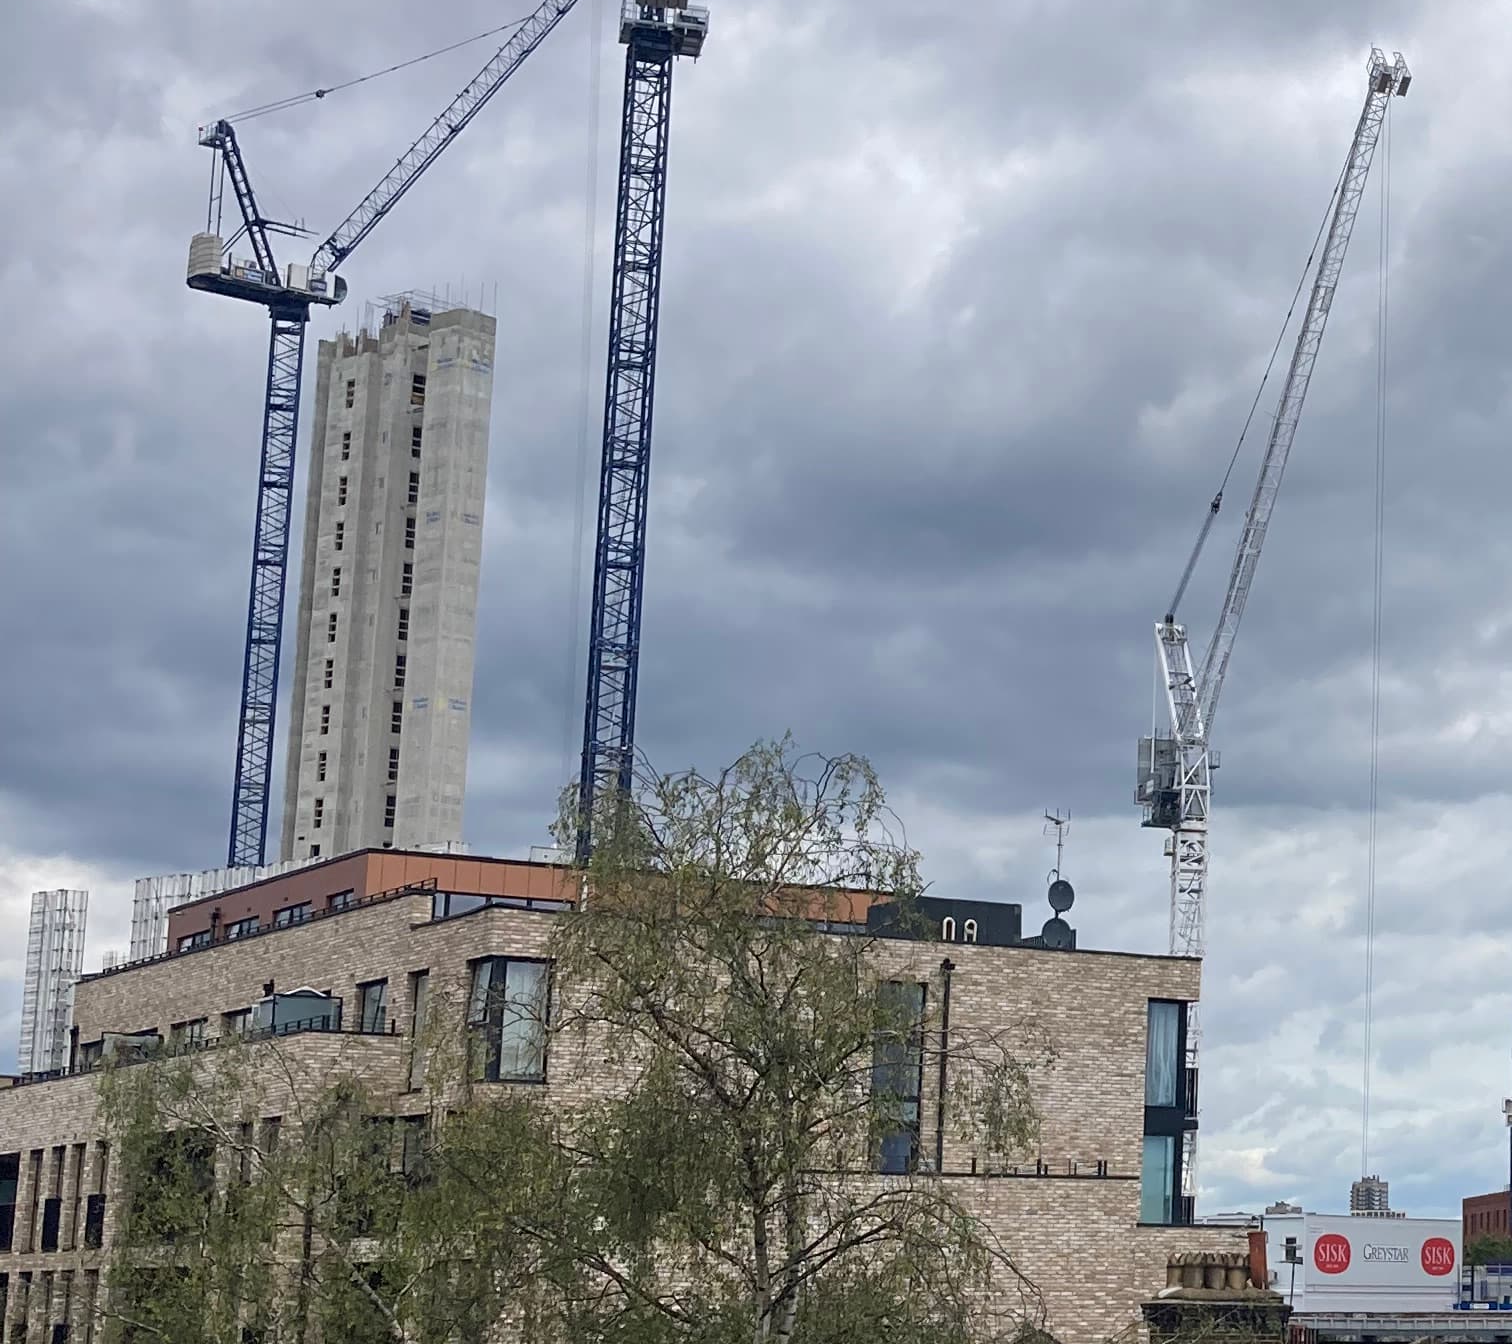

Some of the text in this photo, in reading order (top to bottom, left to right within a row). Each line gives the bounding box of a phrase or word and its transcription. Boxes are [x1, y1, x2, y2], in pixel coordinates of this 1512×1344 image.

[1318, 1243, 1452, 1265] SISK GREYSTAR SISK
